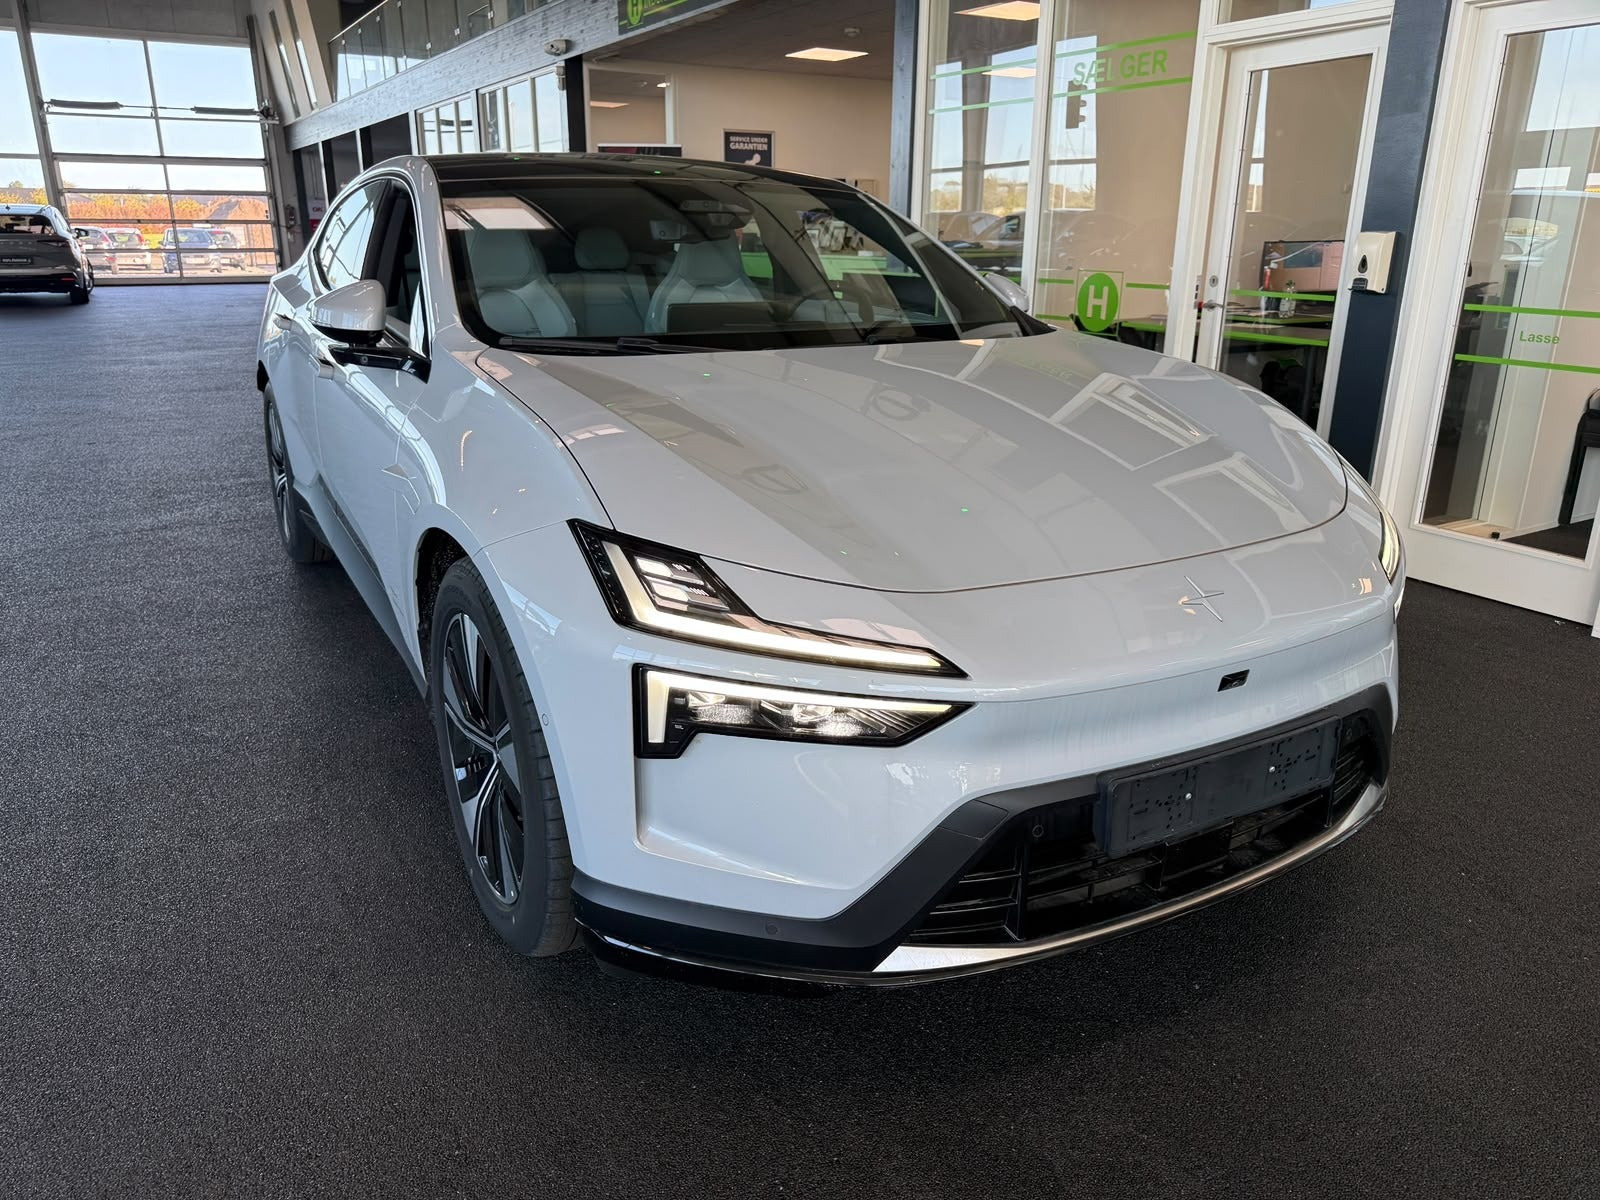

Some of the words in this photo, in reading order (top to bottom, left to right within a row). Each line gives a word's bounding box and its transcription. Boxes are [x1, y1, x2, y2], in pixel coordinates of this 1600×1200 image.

[729, 142, 768, 151] GARANTIEN
[1086, 284, 1109, 321] H
[1519, 330, 1560, 345] Lasse
